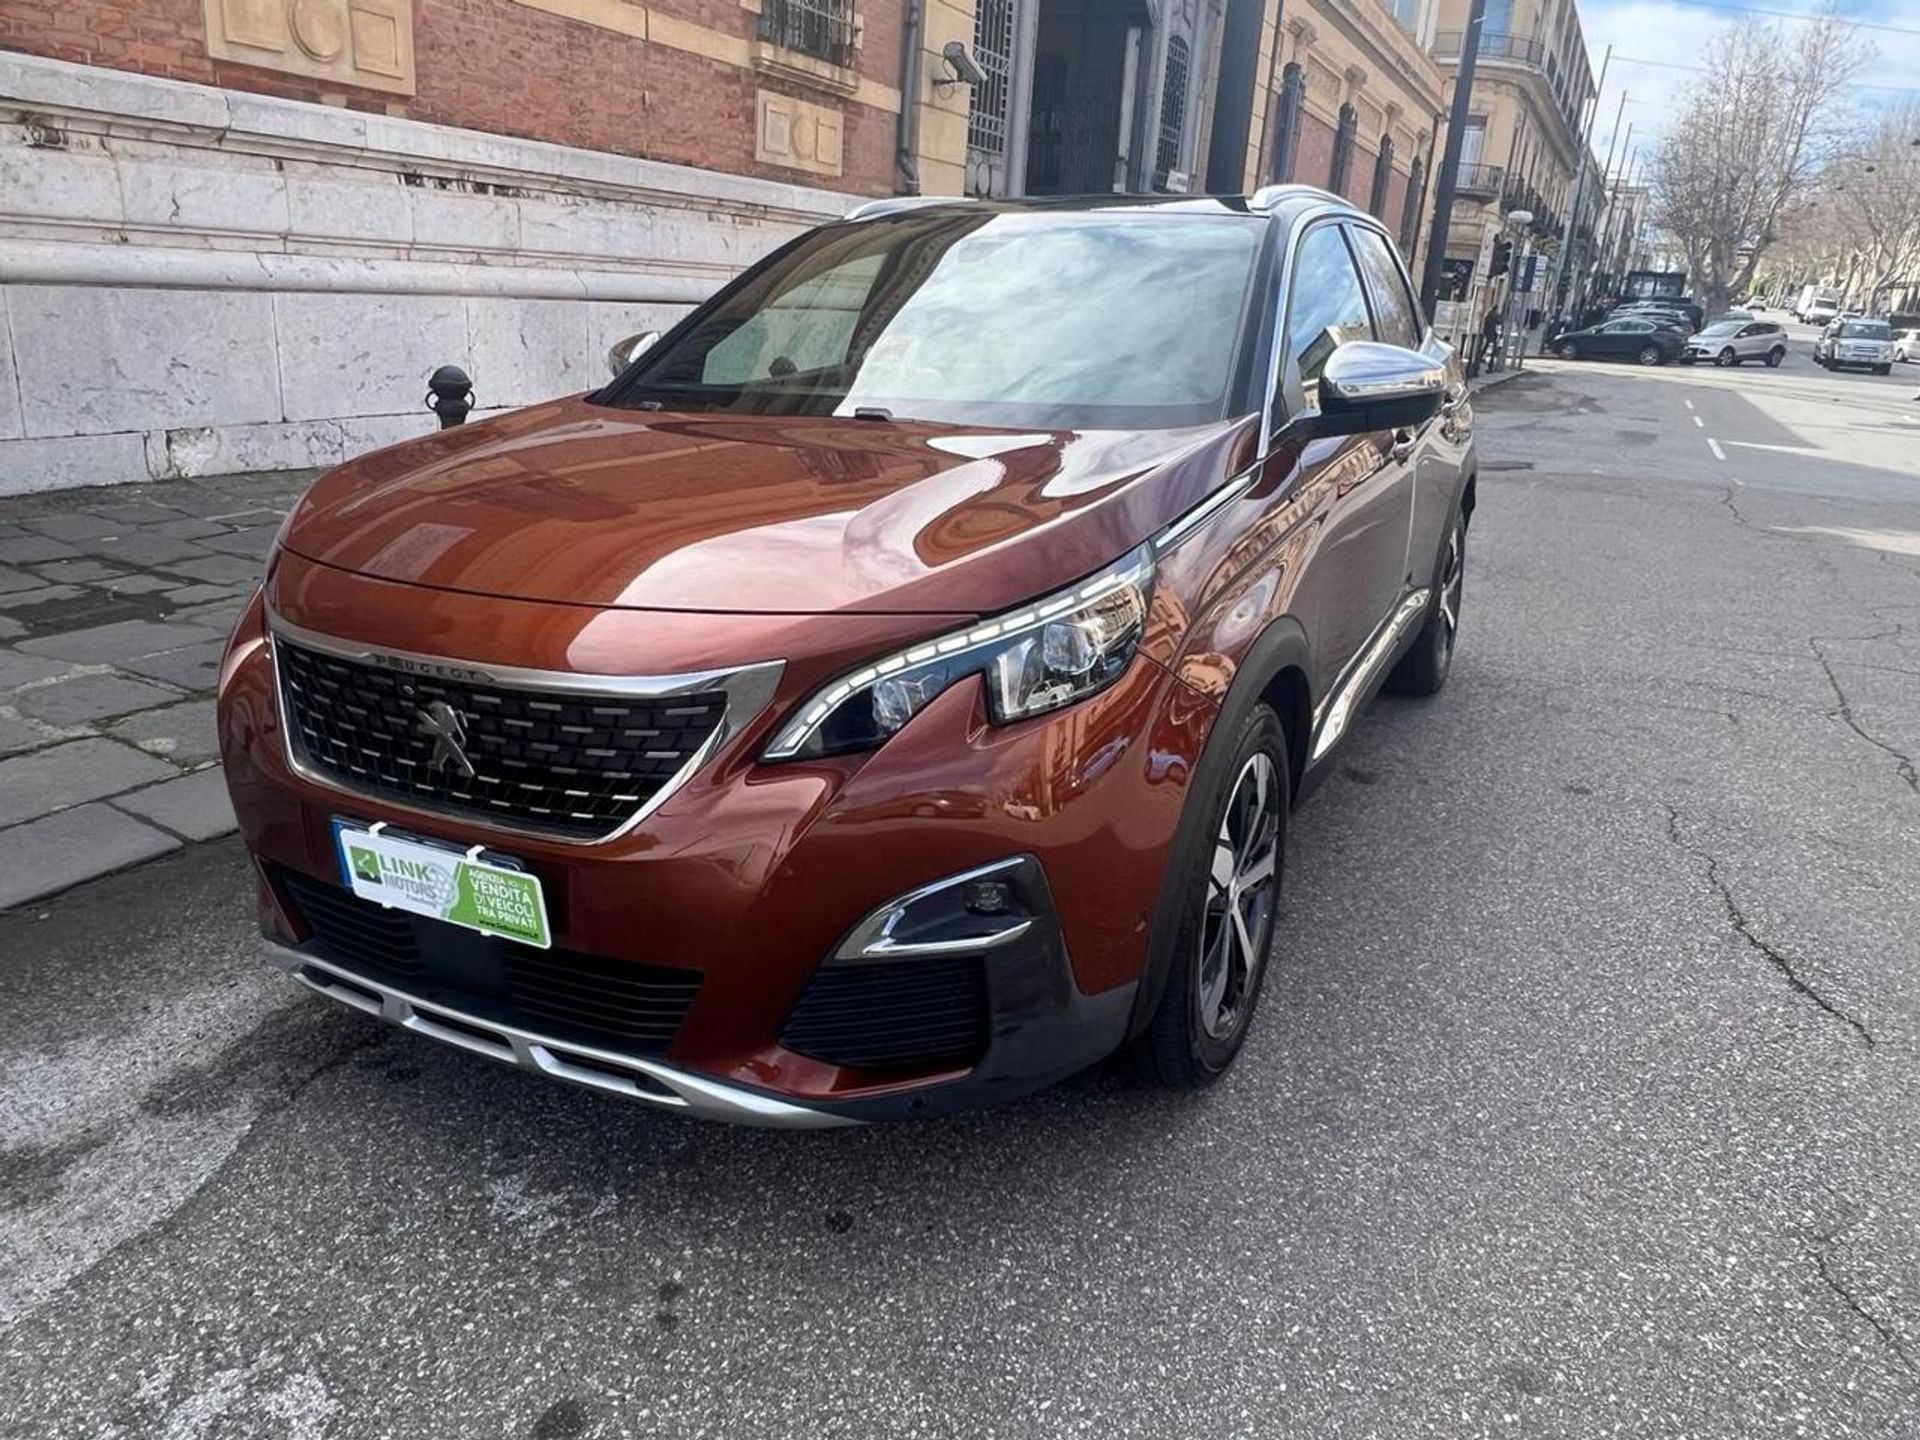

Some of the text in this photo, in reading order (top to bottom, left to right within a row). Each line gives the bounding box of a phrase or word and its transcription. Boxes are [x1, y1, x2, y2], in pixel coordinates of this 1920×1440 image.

[379, 854, 432, 882] LINK
[383, 873, 437, 899] MOTORS
[470, 878, 532, 905] VENDITA
[473, 892, 535, 917] DI VEICOLI
[476, 905, 496, 918] TRA
[498, 911, 537, 929] PRIVATI
